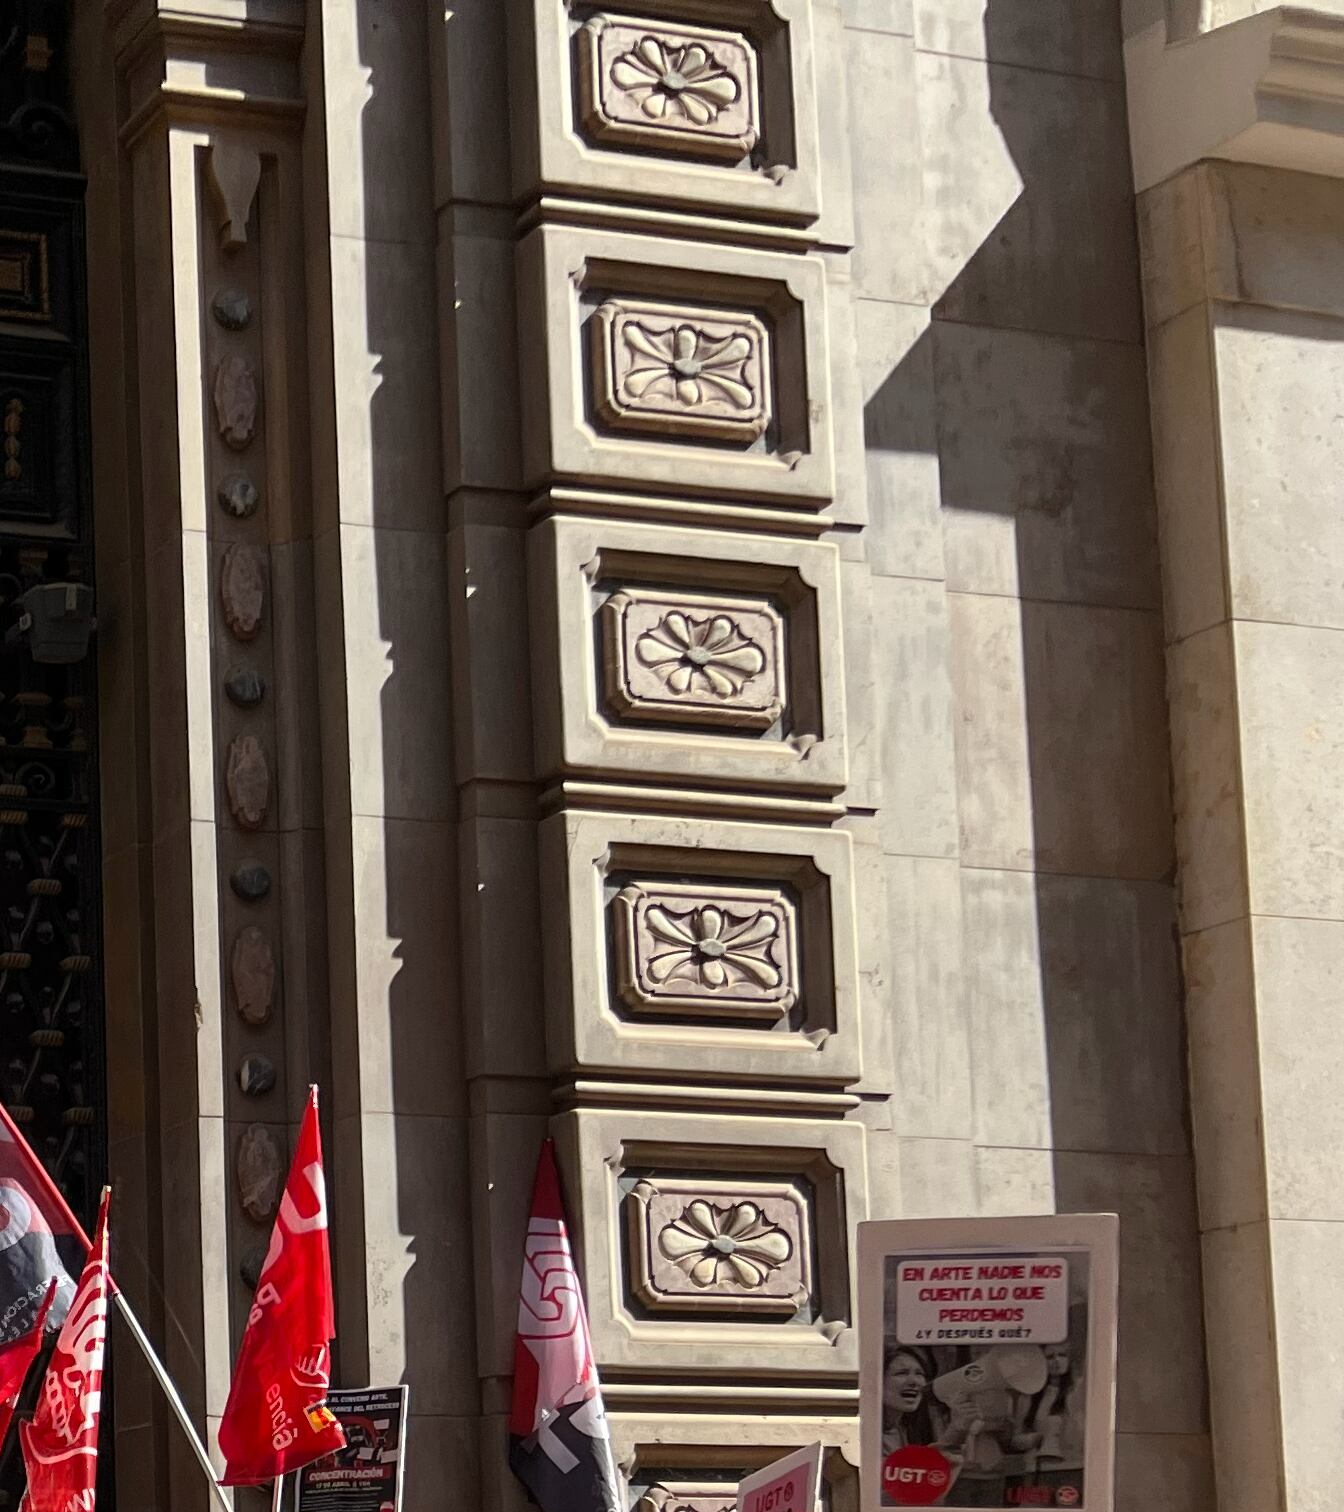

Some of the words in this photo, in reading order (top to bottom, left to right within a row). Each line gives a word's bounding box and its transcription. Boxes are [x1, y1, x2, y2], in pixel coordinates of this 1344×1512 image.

[903, 1266, 924, 1281] EN
[929, 1266, 973, 1281] ARTE
[978, 1265, 1024, 1280] NADIE
[1030, 1265, 1062, 1280] NOS
[918, 1287, 982, 1301] CUENTA
[988, 1286, 1009, 1301] LO
[1012, 1286, 1045, 1301] QUE
[939, 1308, 1024, 1323] PERDEMOS
[915, 1329, 933, 1339] ¿Y
[937, 1327, 993, 1339] DESPUÉS
[998, 1327, 1032, 1339] QUÉ?
[885, 1466, 927, 1484] UGT
